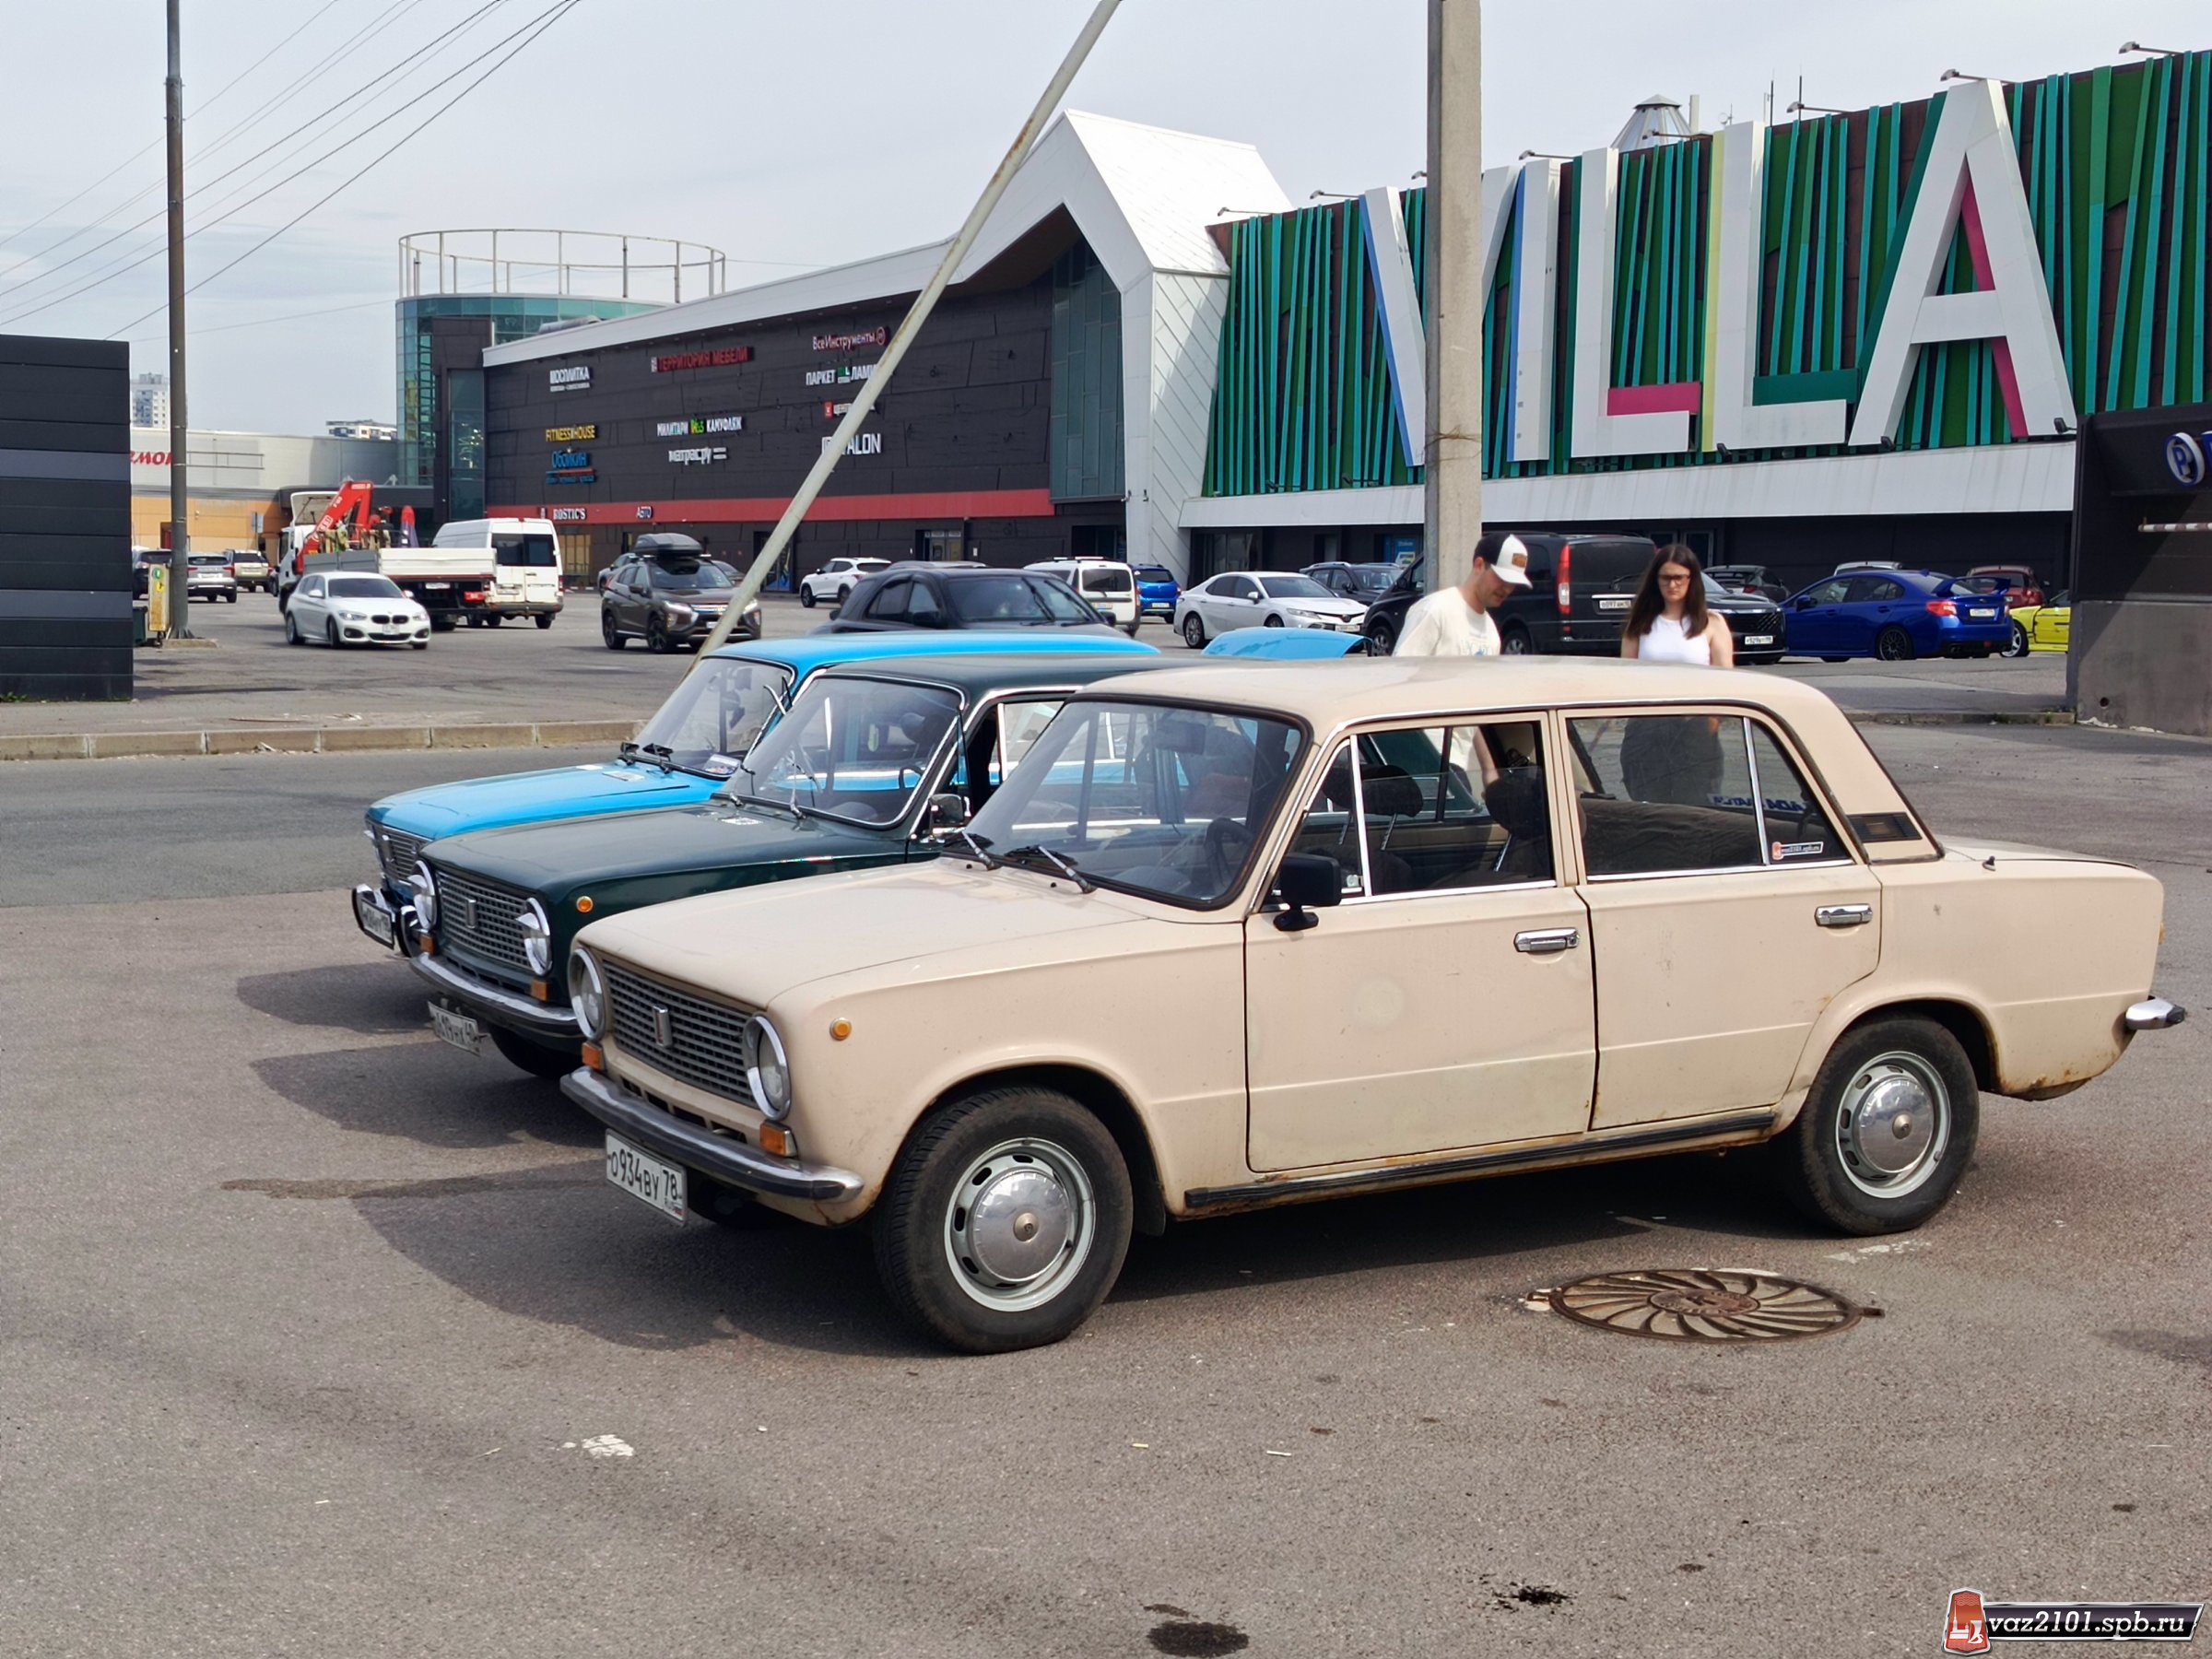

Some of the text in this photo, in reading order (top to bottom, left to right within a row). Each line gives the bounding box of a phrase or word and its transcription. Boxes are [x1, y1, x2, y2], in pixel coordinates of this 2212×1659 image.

[1359, 79, 2076, 466] VILLA
[658, 352, 711, 371] ТЕРРИТОРИЯ
[712, 347, 747, 365] МЕБЕЛИ
[806, 370, 836, 385] ПАРКЕТ
[546, 425, 595, 442] FITNESS HOUSE
[656, 421, 688, 437] МИЛИТАРИ
[706, 417, 742, 433] КАМУФЛЯЖ
[553, 508, 586, 521] ROSTIC'S
[663, 1170, 678, 1201] 78
